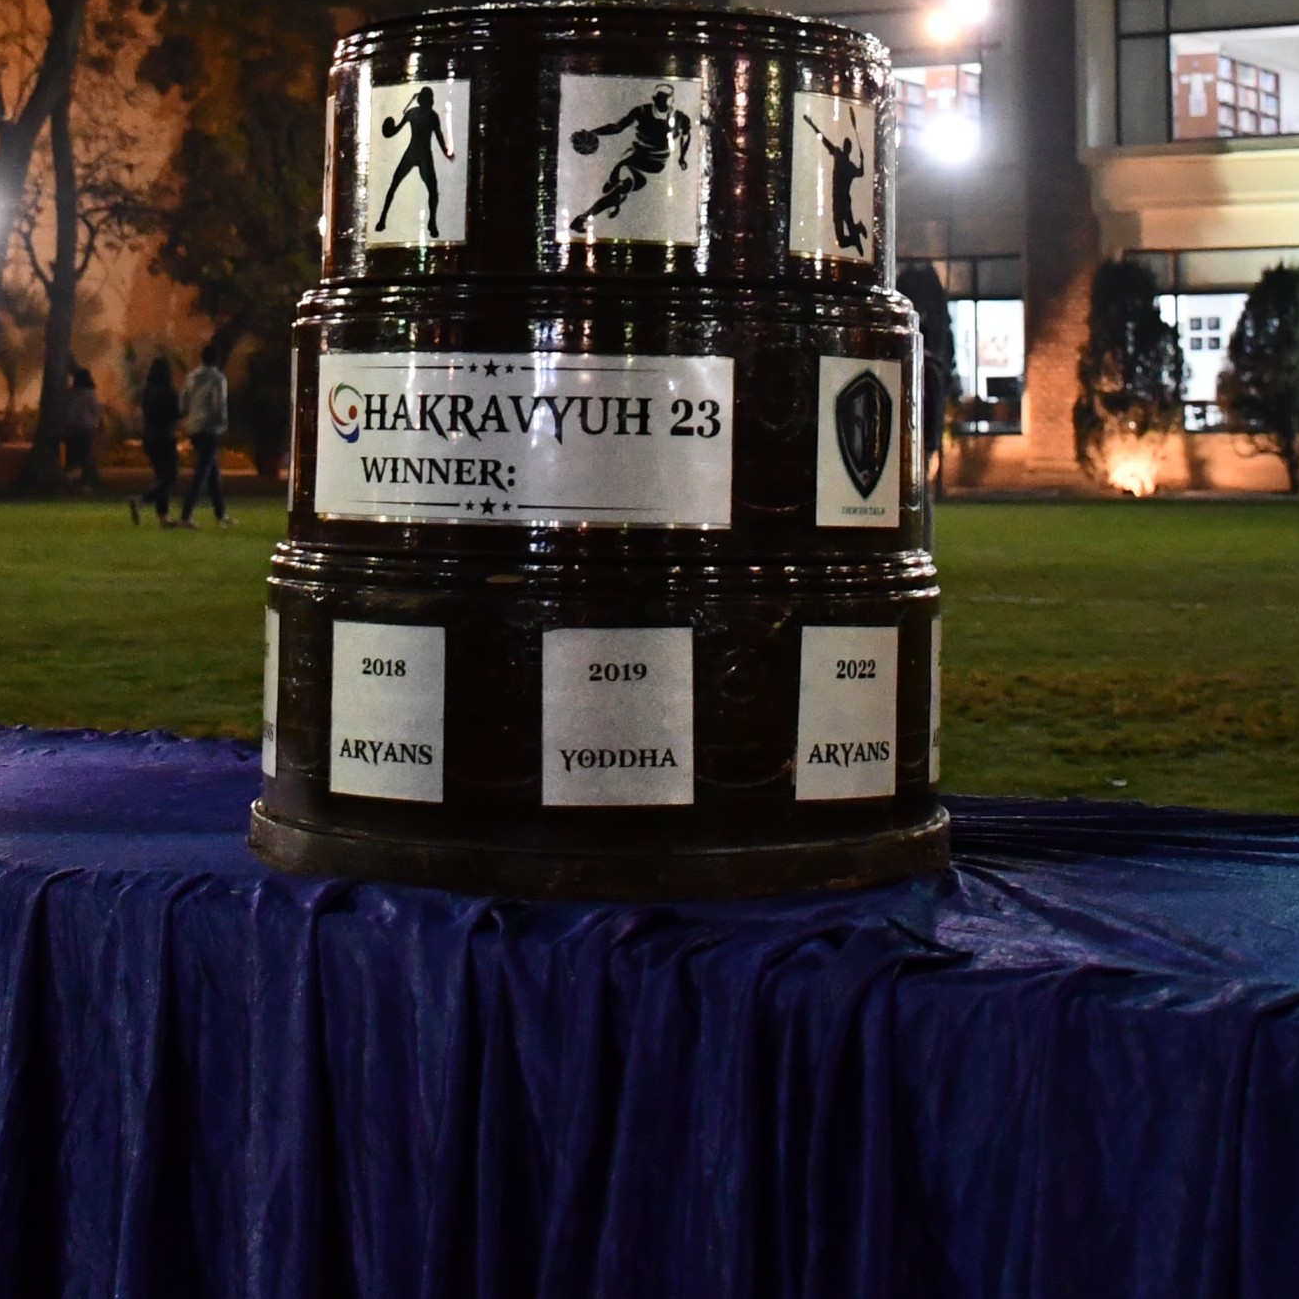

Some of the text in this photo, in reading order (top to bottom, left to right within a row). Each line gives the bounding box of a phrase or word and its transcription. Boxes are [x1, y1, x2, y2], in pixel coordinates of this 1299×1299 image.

[670, 398, 722, 439] 23
[360, 456, 516, 492] WINNER:
[362, 657, 407, 677] 2018
[589, 663, 648, 682] 2019
[836, 659, 877, 679] 2022
[339, 738, 434, 766] ARYANS
[559, 747, 679, 774] YODDHA
[807, 740, 891, 768] ARYANS
